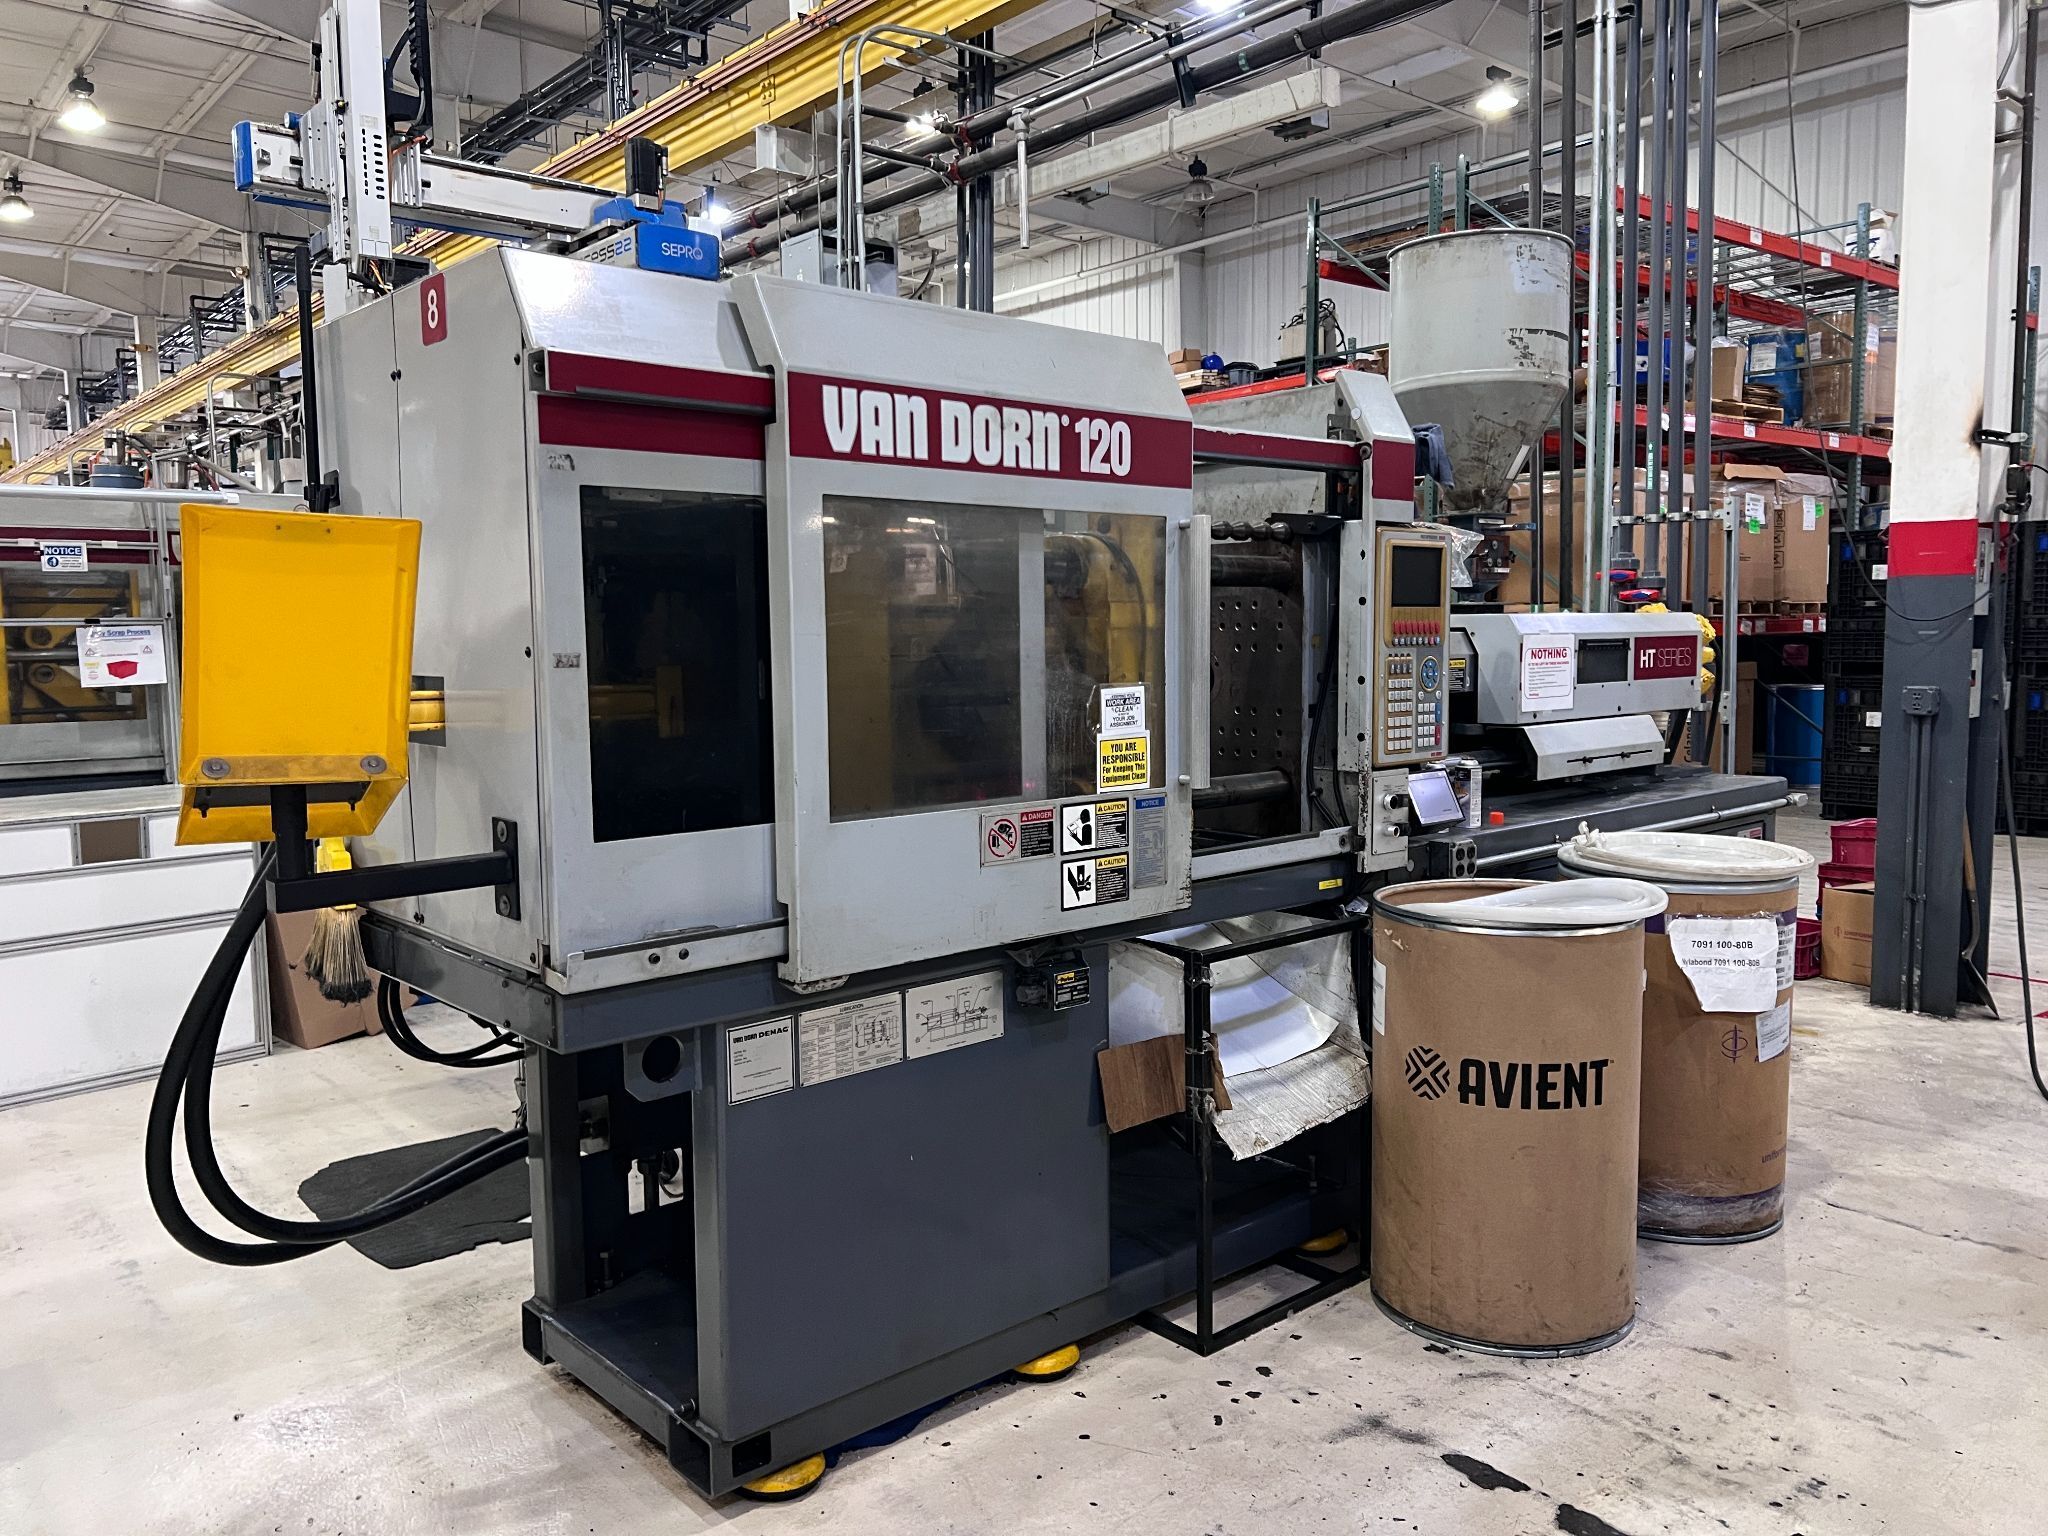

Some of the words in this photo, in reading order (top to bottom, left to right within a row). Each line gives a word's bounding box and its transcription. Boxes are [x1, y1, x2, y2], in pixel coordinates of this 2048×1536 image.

[661, 242, 704, 260] SEPRO
[427, 288, 439, 330] 8
[822, 384, 929, 460] VAN
[1074, 417, 1131, 477] 120
[45, 547, 82, 555] NOTICE
[1531, 648, 1568, 660] NOTHING
[1640, 649, 1656, 668] HT
[1657, 647, 1691, 667] SERIES
[1106, 699, 1124, 707] WORK
[1125, 697, 1140, 705] AREA
[1114, 705, 1133, 713] CLEAN
[1110, 720, 1138, 728] ASSIGNMENT
[1111, 743, 1123, 753] YOU
[1125, 742, 1136, 751] ARE
[1102, 752, 1145, 765] RESPONSIBLE
[1103, 766, 1111, 774] For
[1113, 764, 1134, 774] Keeping
[1135, 762, 1145, 770] This
[1103, 774, 1130, 784] Equipment
[1132, 772, 1145, 780] Clean
[1104, 803, 1125, 811] CAUTION
[1028, 811, 1052, 821] DANGER
[1104, 857, 1126, 866] CAUTION
[1691, 940, 1713, 949] 7091
[1716, 941, 1753, 949] 100-80B
[1713, 958, 1730, 966] 7091
[840, 1003, 863, 1012] LUBRICATION
[1457, 1057, 1609, 1110] AVIENT
